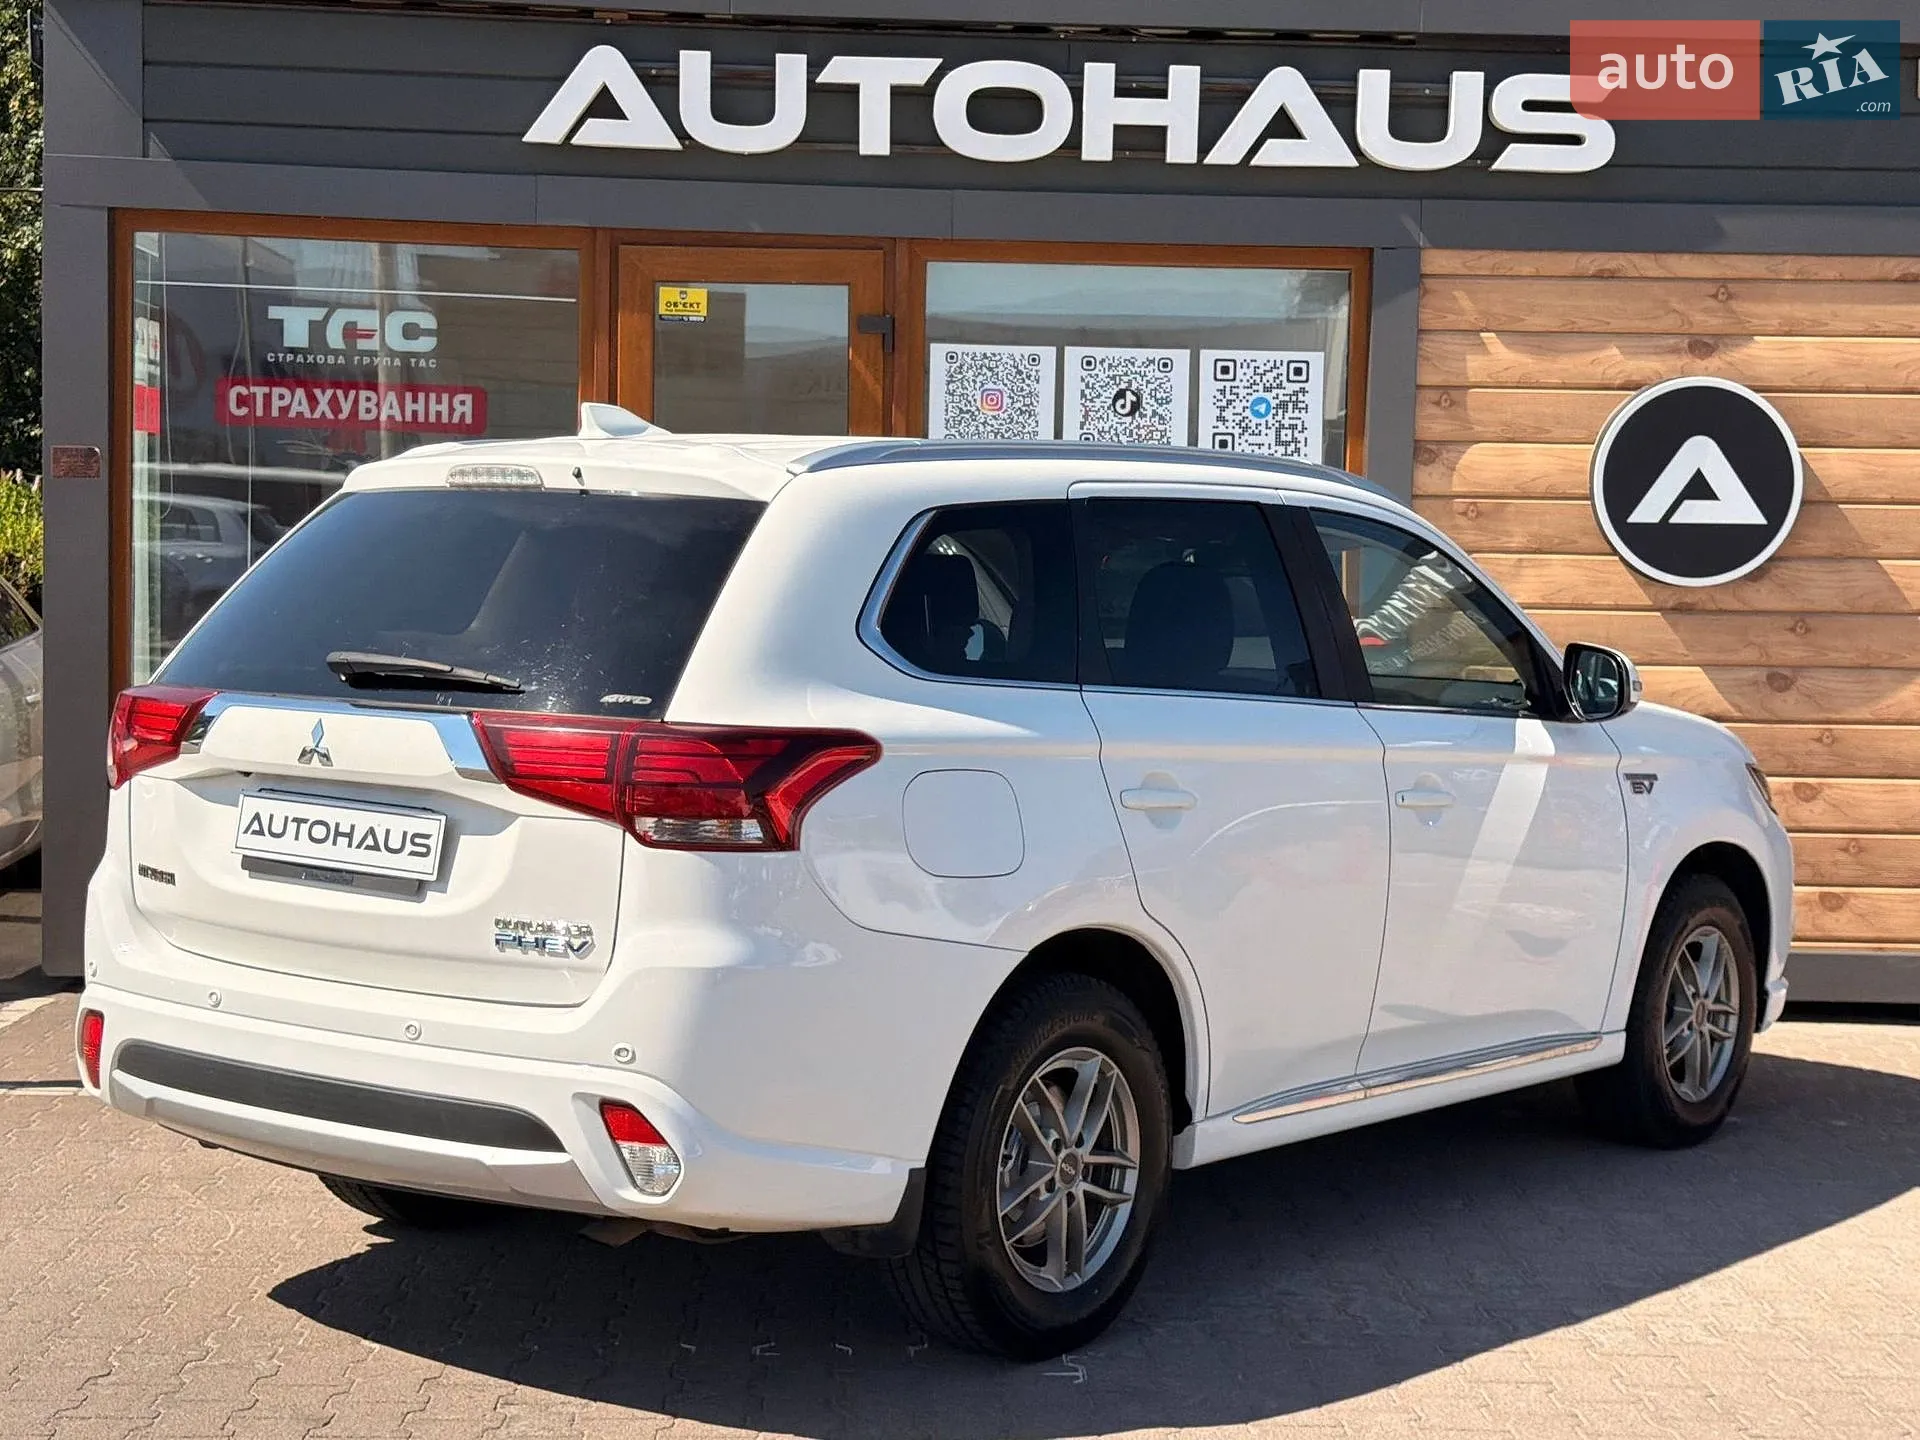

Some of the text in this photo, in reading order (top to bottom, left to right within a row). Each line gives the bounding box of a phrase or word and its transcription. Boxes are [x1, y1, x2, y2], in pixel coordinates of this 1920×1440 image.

[523, 44, 1617, 174] AUTOHAUS
[266, 352, 438, 369] СТРАХОВА ГРУПА ТАС
[228, 384, 474, 424] СТРАХУВАННЯ
[1632, 782, 1654, 795] EV
[242, 811, 434, 859] AUTOHAUS
[494, 931, 595, 957] PHEV
